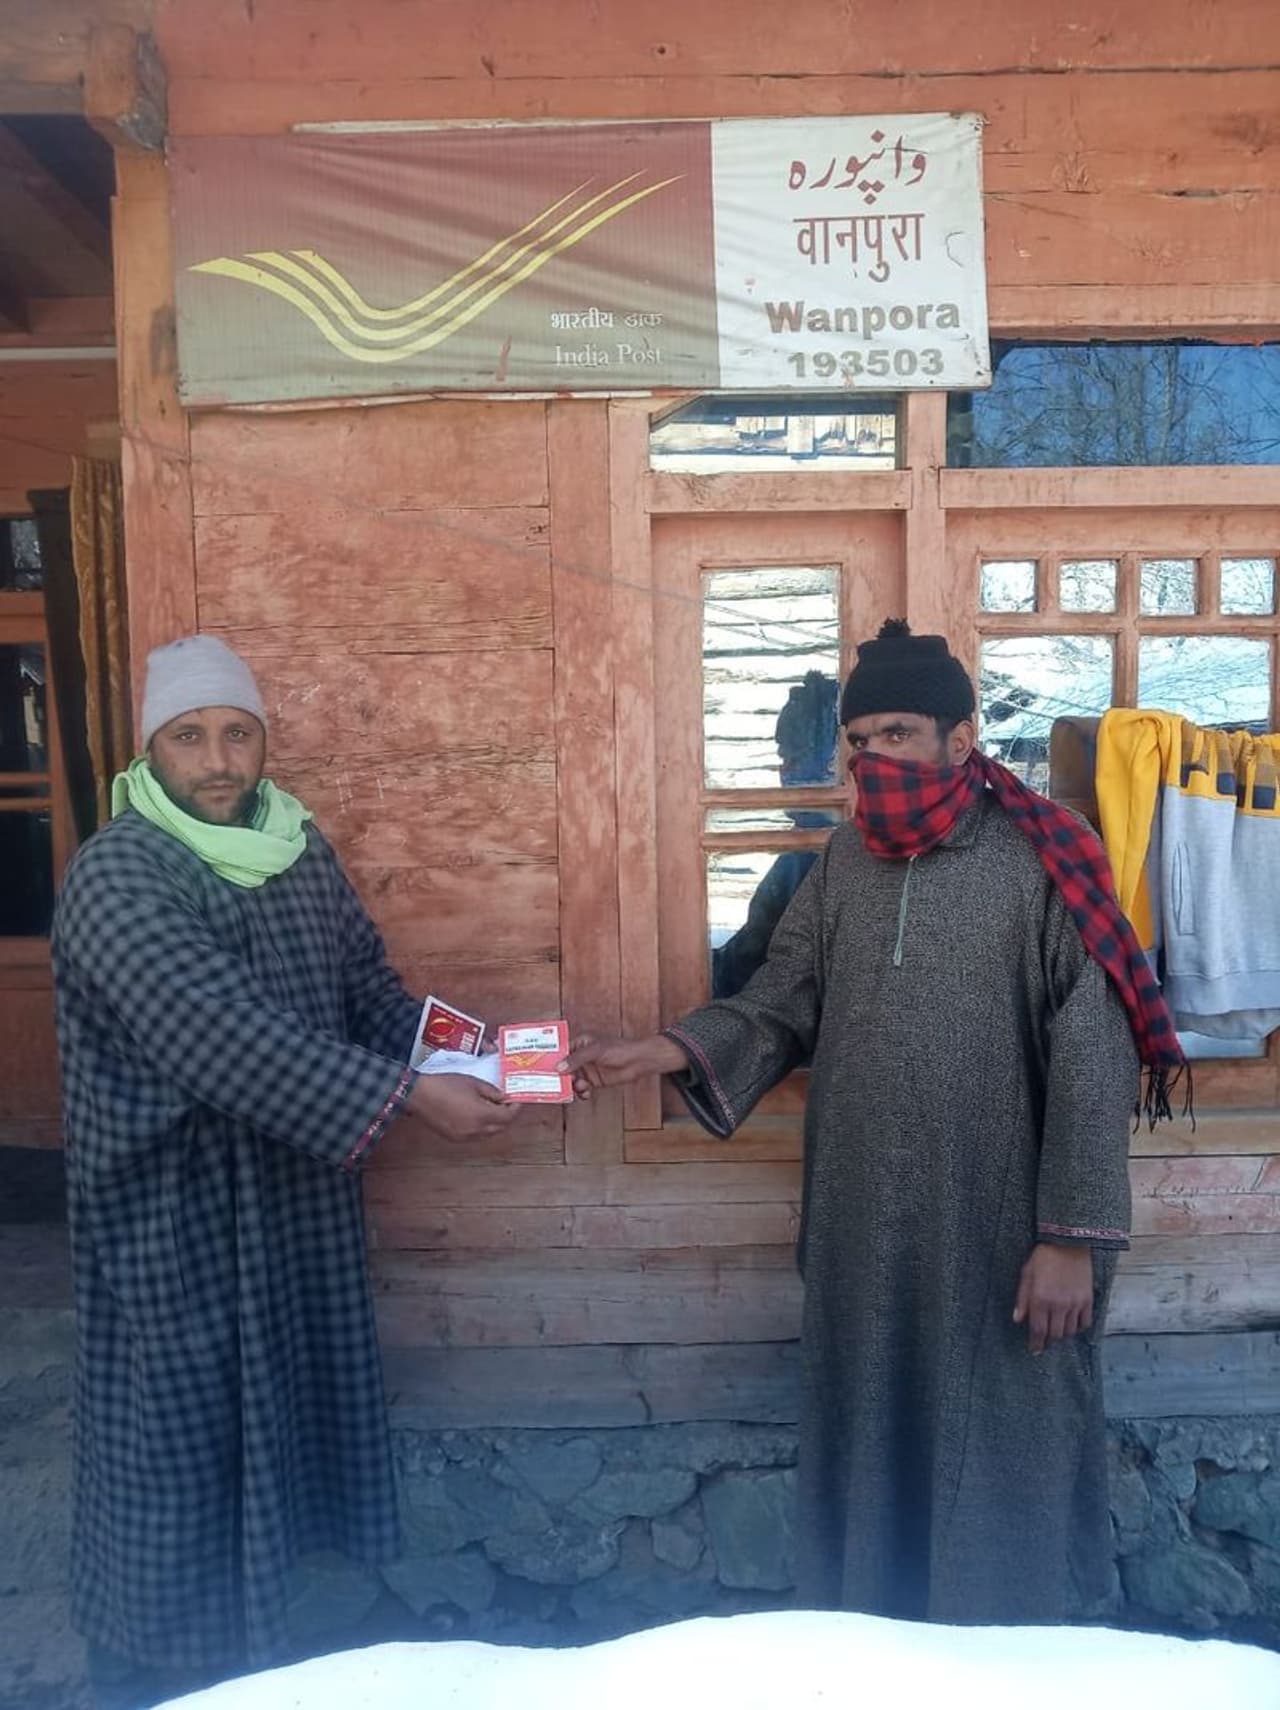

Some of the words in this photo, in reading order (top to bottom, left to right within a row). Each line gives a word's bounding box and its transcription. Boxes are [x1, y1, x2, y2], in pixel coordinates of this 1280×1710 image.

[793, 213, 925, 282] वानपुरा
[551, 307, 614, 329] भारतीय
[624, 312, 664, 328] डाक
[765, 302, 960, 340] Wanpora
[555, 344, 609, 367] India
[617, 344, 662, 364] Post
[788, 348, 944, 378] 193503
